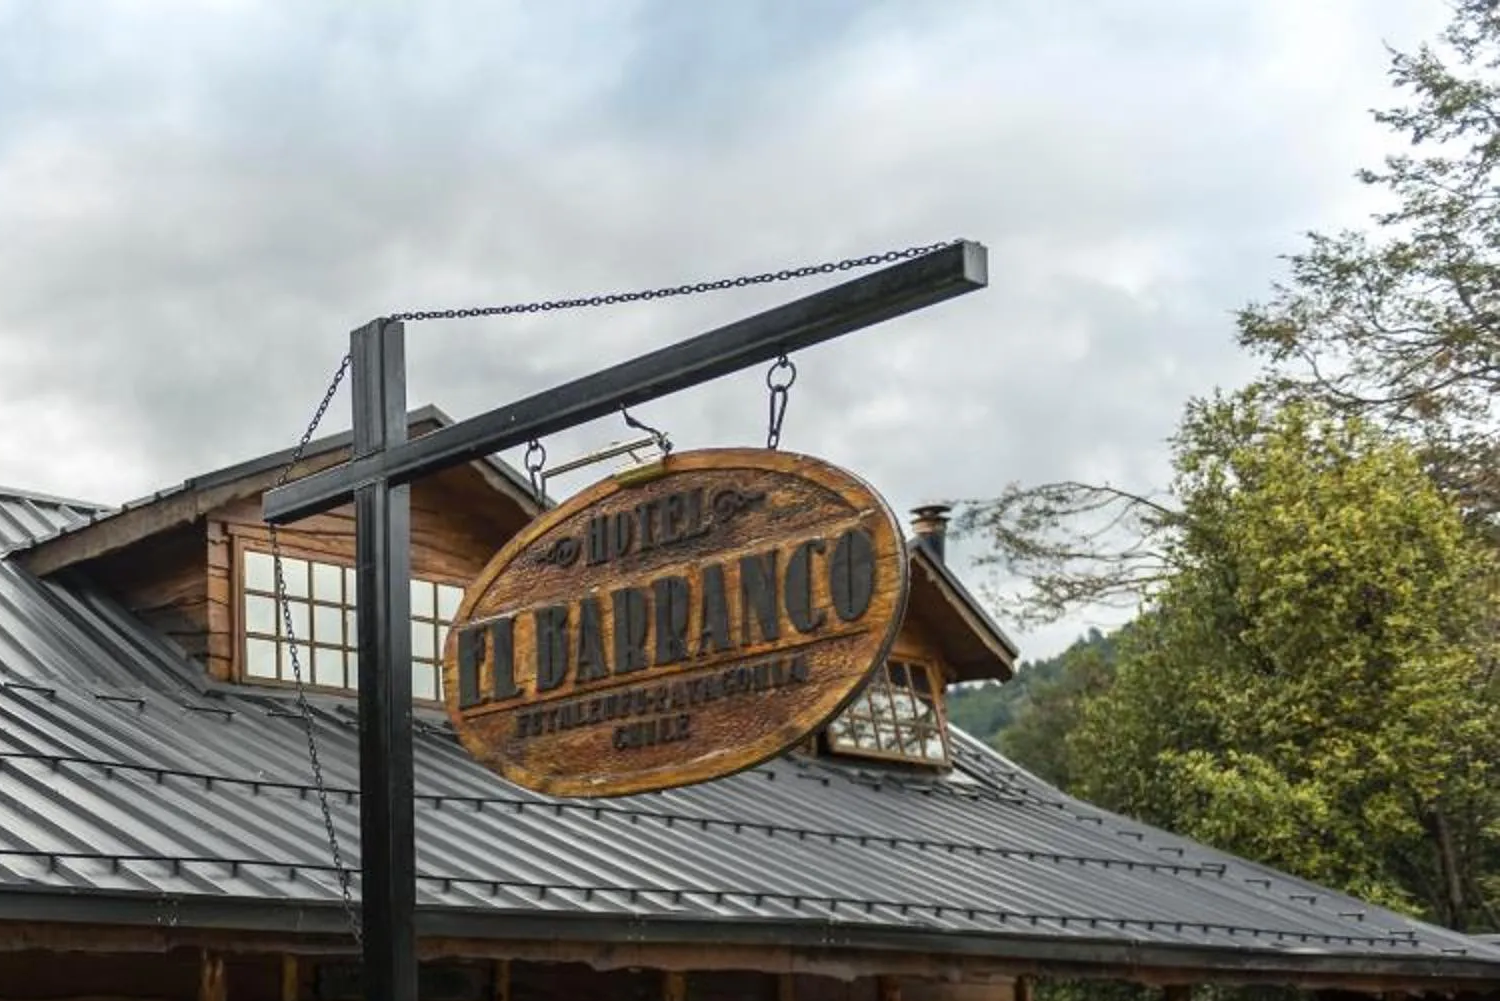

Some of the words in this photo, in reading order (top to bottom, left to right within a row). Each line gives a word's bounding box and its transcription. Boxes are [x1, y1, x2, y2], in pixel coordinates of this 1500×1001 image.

[586, 488, 708, 566] HOTEL
[457, 614, 524, 710] EL
[535, 528, 877, 693] BARRANCO
[612, 711, 691, 750] CHILE
